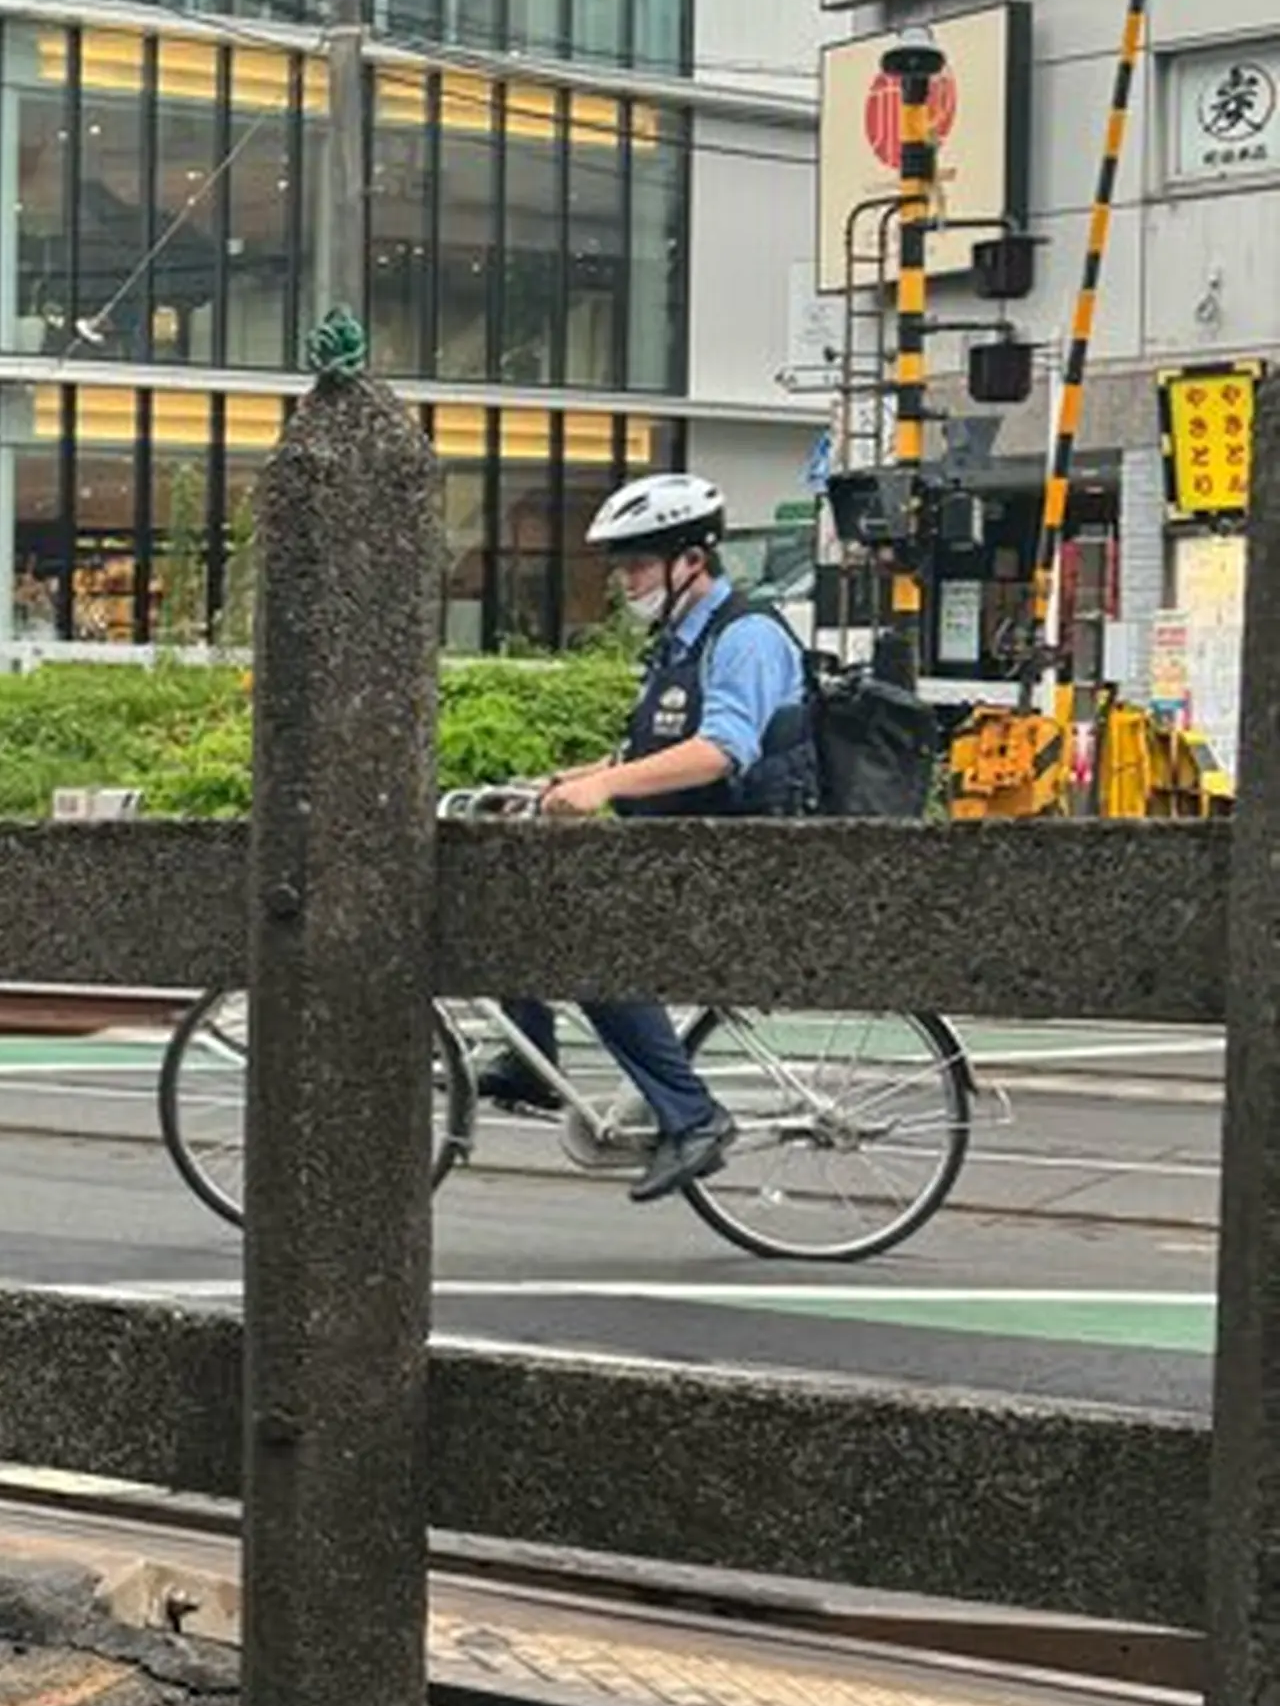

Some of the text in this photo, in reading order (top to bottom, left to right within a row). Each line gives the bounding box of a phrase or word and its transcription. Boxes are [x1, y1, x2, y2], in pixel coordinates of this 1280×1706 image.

[1202, 65, 1263, 134] 炭
[1185, 385, 1214, 496] やきとり
